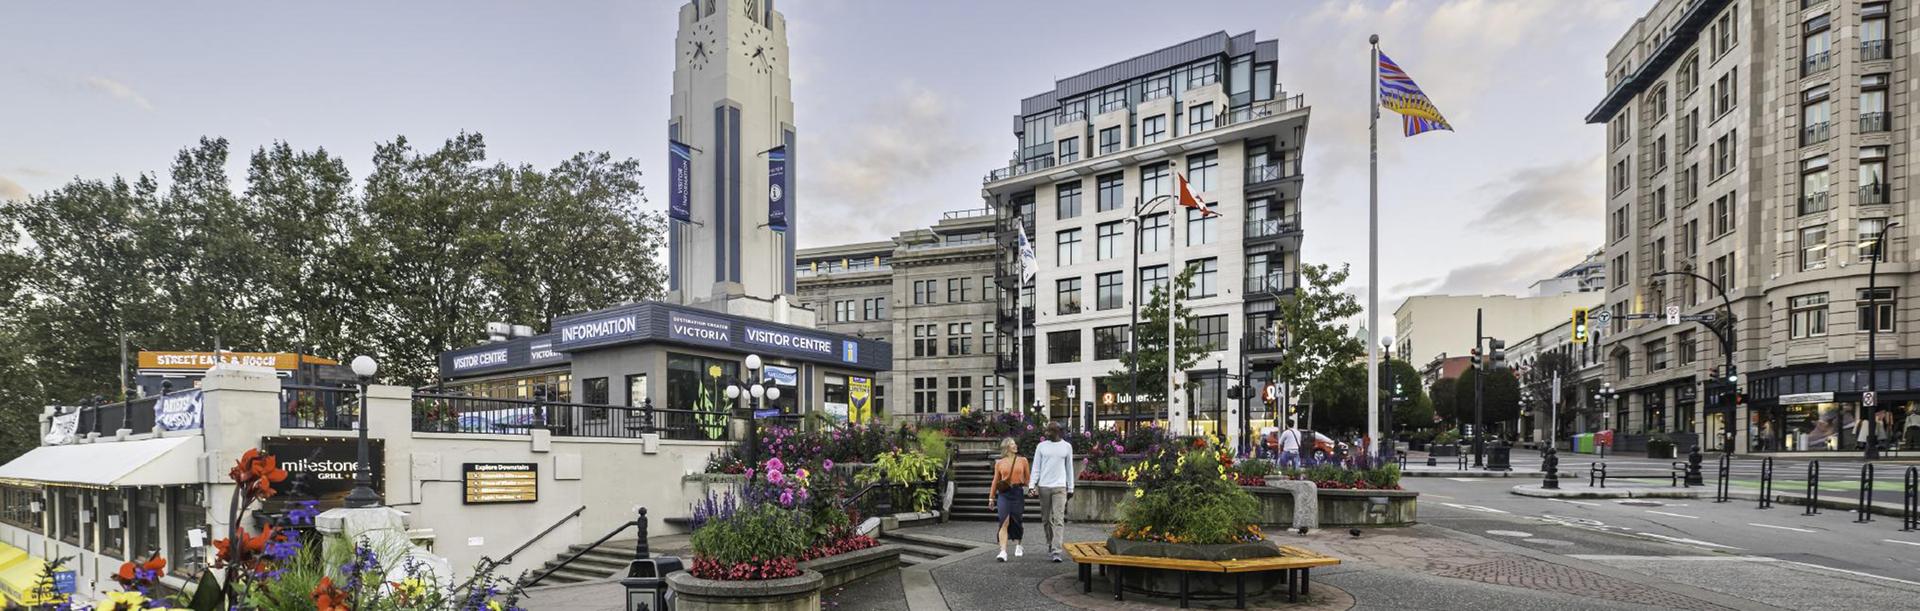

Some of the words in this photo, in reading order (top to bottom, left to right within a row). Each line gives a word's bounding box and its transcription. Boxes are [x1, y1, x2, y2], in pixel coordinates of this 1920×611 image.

[562, 316, 636, 342] INFORMATION
[674, 324, 728, 341] VICTORIA
[747, 328, 790, 346] VISITOR
[792, 336, 832, 353] CENTRE
[157, 354, 197, 365] STREET
[242, 355, 276, 366] HOOCH
[454, 355, 479, 369] VISITOR
[479, 350, 507, 365] CENTRE
[318, 472, 343, 480] GRILL
